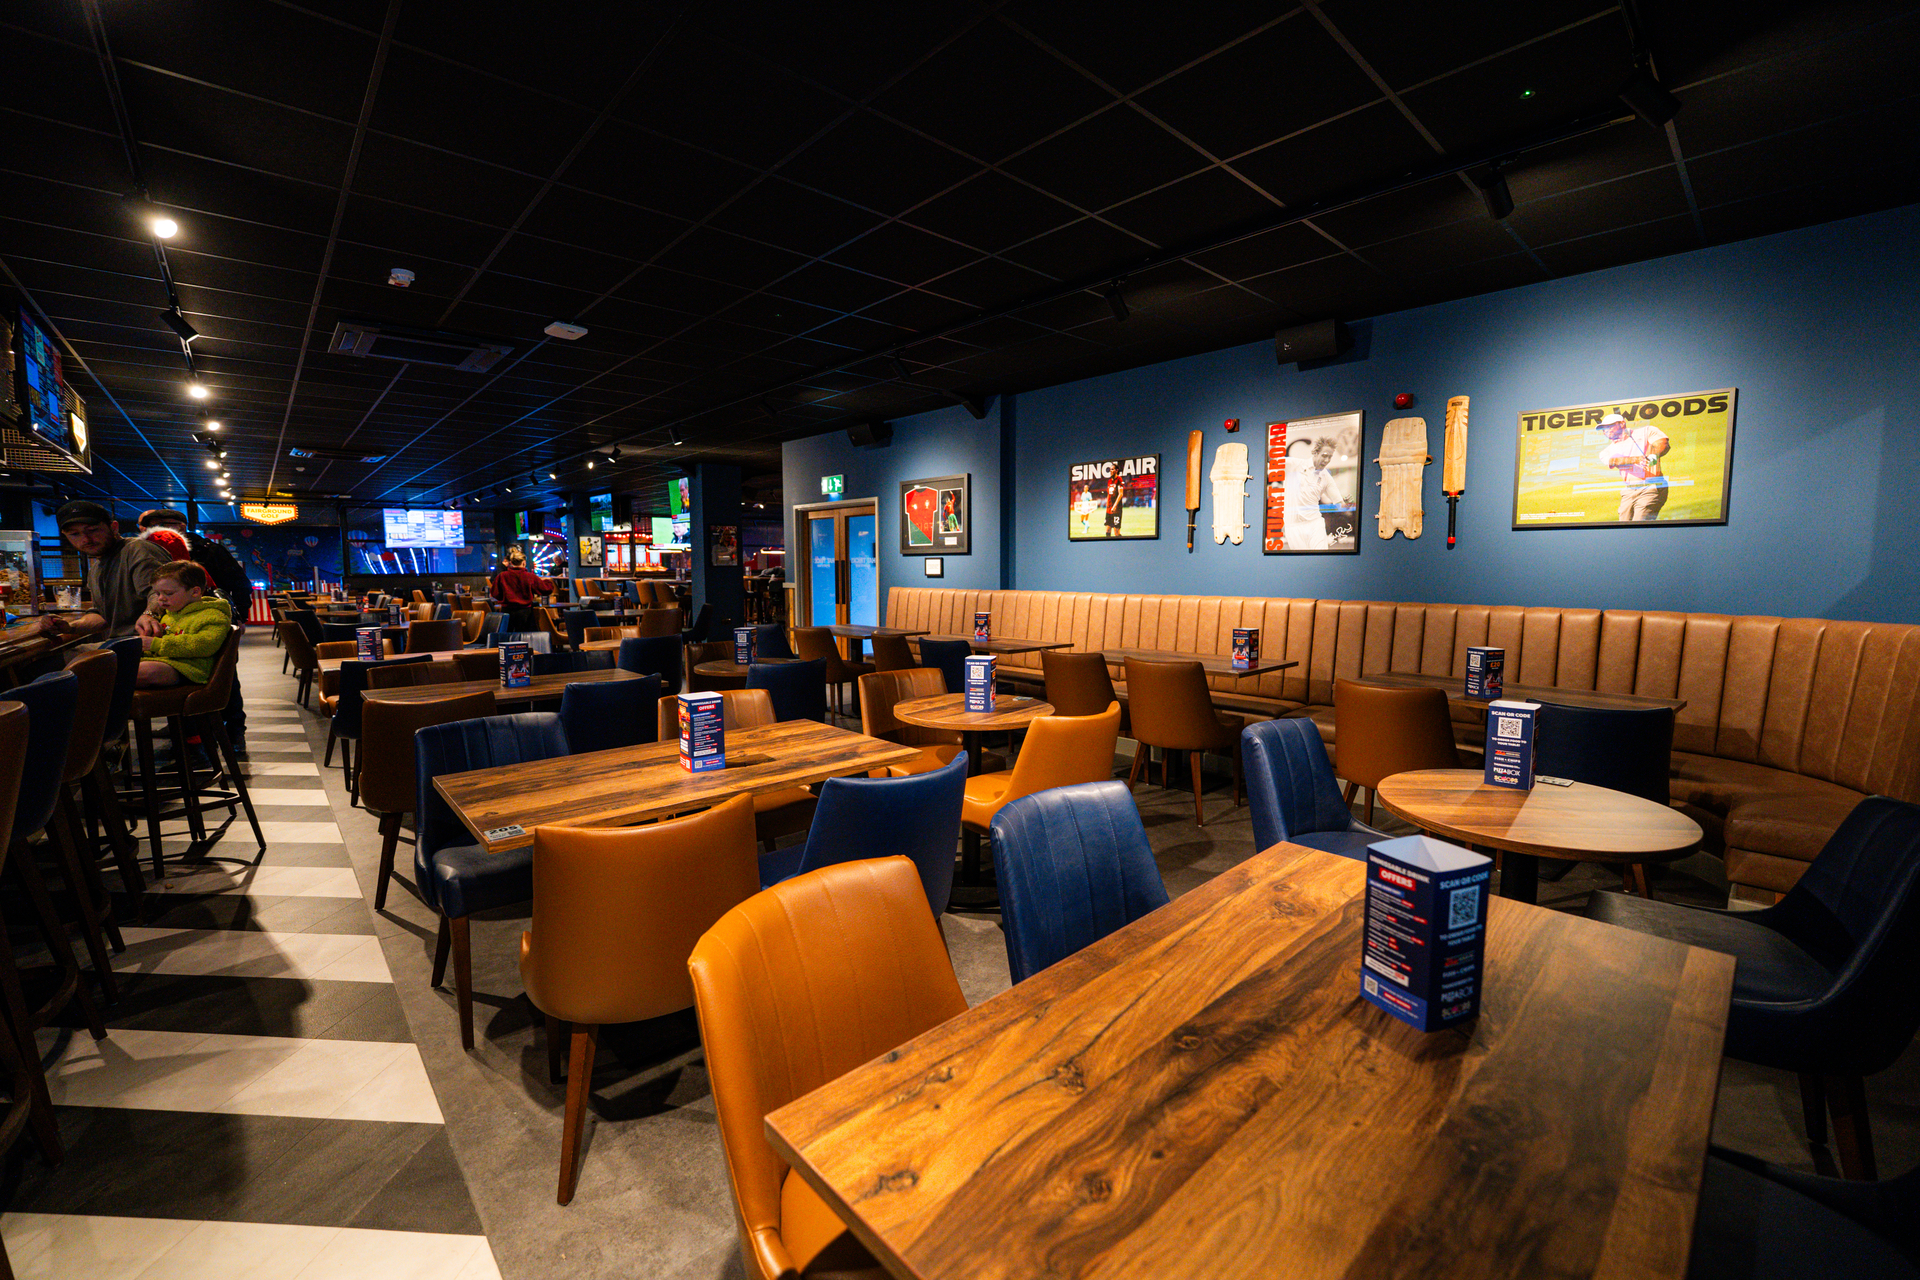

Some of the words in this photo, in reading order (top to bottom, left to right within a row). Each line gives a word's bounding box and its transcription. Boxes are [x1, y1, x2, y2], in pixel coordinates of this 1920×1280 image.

[1522, 409, 1604, 431] TIGER
[1613, 395, 1729, 421] WOODS
[1268, 423, 1287, 483] BROAD
[1071, 457, 1156, 482] SINCAIR
[1266, 486, 1285, 551] STUART
[1380, 870, 1413, 888] OFFERS
[1440, 879, 1460, 890] SCAN
